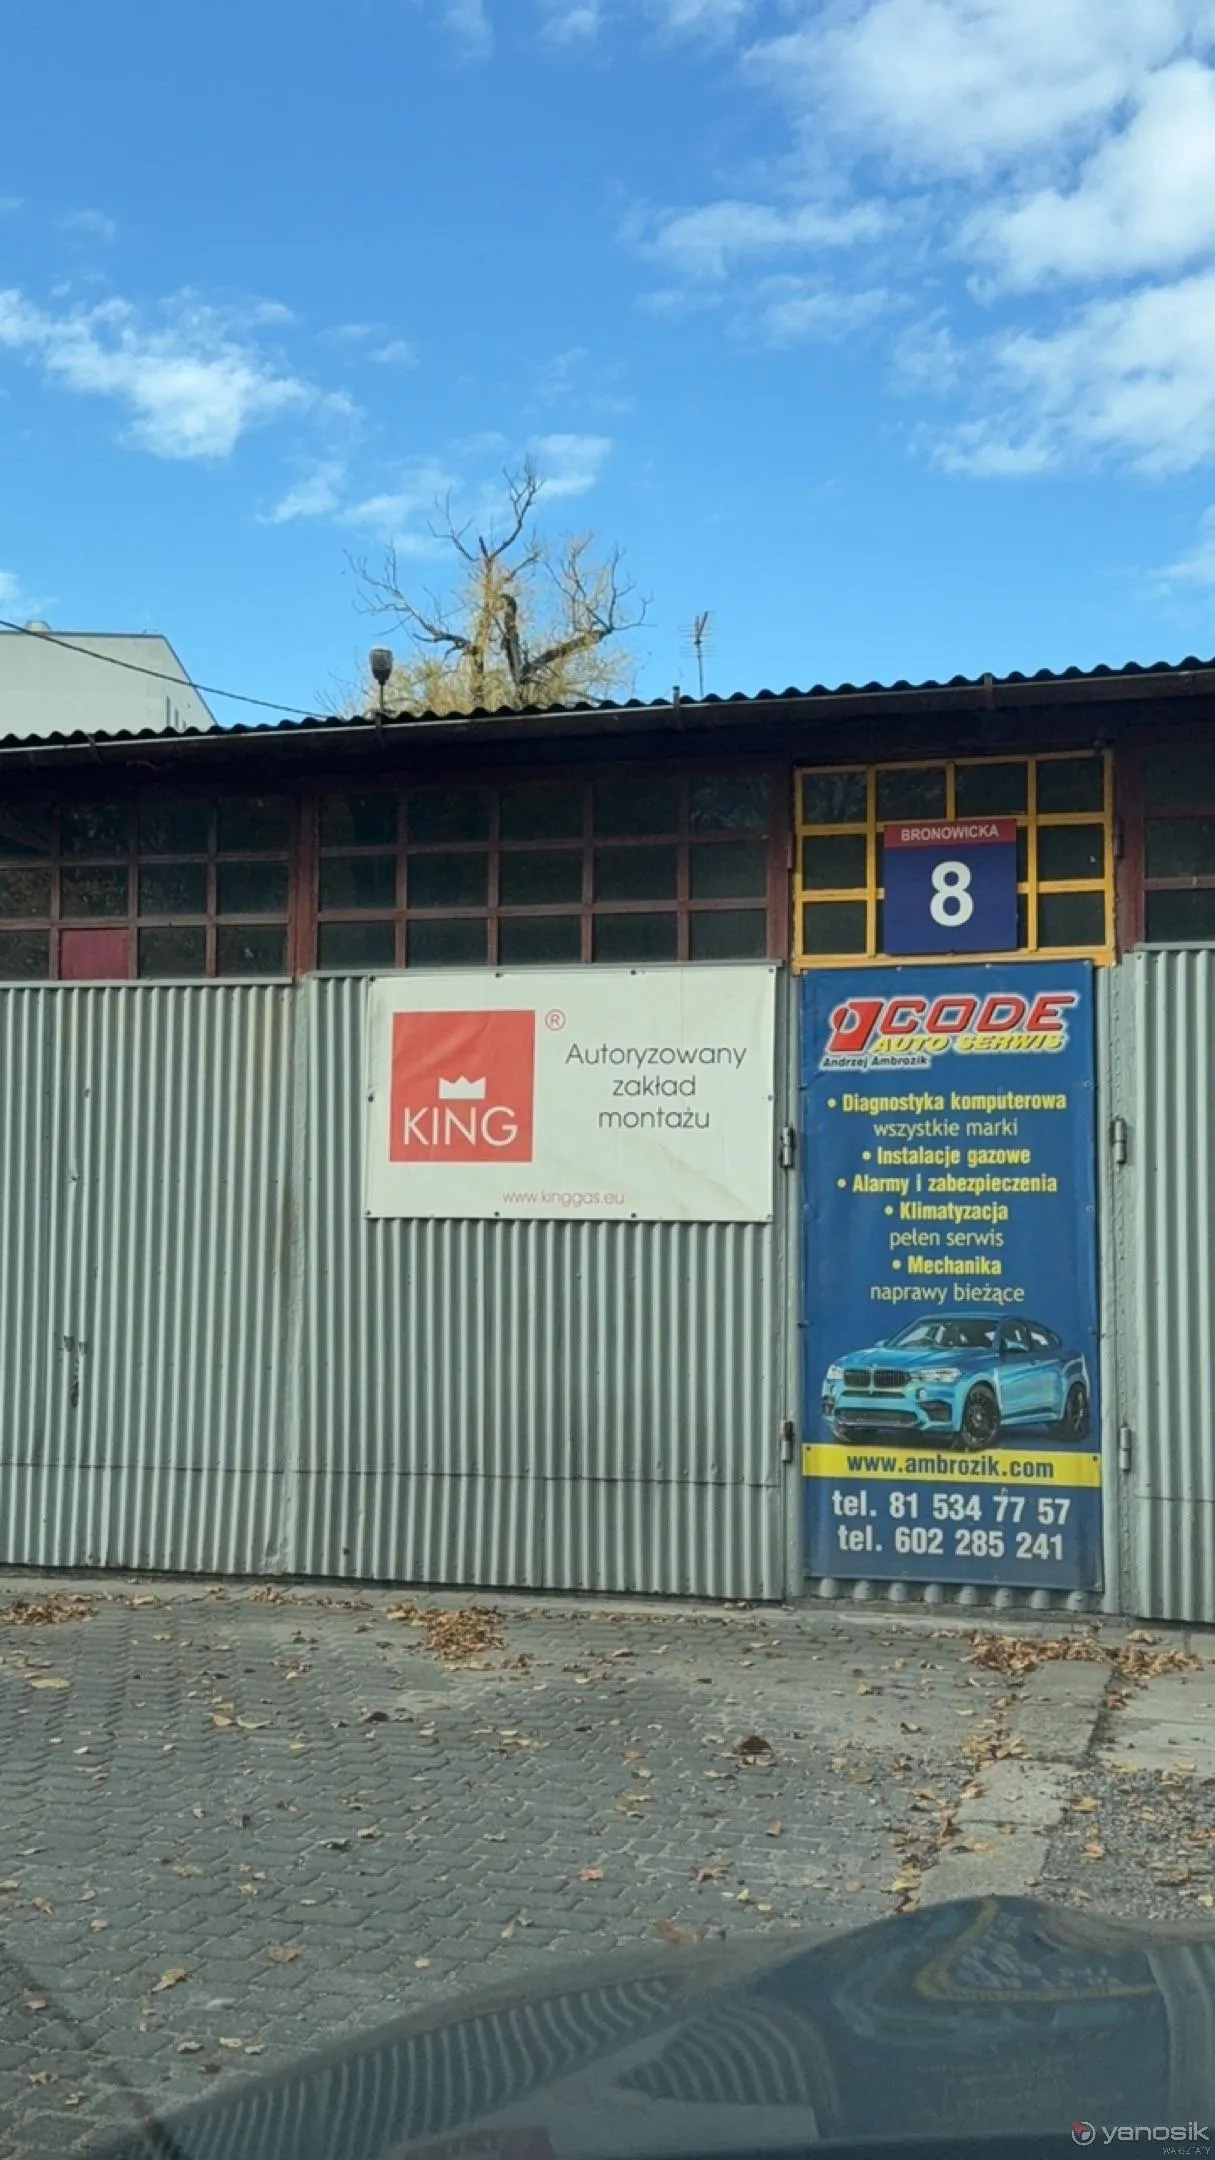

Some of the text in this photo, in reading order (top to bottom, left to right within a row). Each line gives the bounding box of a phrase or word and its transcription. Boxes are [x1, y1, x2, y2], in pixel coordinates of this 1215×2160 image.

[900, 824, 999, 841] BRONOWICKA
[930, 861, 974, 927] 8
[872, 1032, 1067, 1053] AUTO SERWIS
[565, 1043, 748, 1069] Autoryzowany
[822, 1055, 928, 1069] Andrzej Ambrozik
[612, 1075, 697, 1097] zakład
[842, 1092, 1067, 1115] Diagnostyka komputerowa
[403, 1106, 519, 1147] KING
[598, 1107, 711, 1129] montażu
[873, 1119, 1019, 1140] wszystkie marki
[877, 1146, 1031, 1168] Instalacje gazowe
[853, 1175, 1058, 1195] Alarmy i zabezpieczenia
[503, 1189, 626, 1207] www.kinggas.eu
[900, 1202, 1008, 1224] Klimatyzacja
[890, 1229, 1004, 1250] pełen serwis
[908, 1255, 1002, 1275] Mechanika
[870, 1283, 1024, 1306] naprawy bieżące
[847, 1454, 1054, 1478] www.ambrozik.com
[832, 1490, 1071, 1525] tel. 81 534 77 57
[838, 1525, 1063, 1560] tel. 602 285 241
